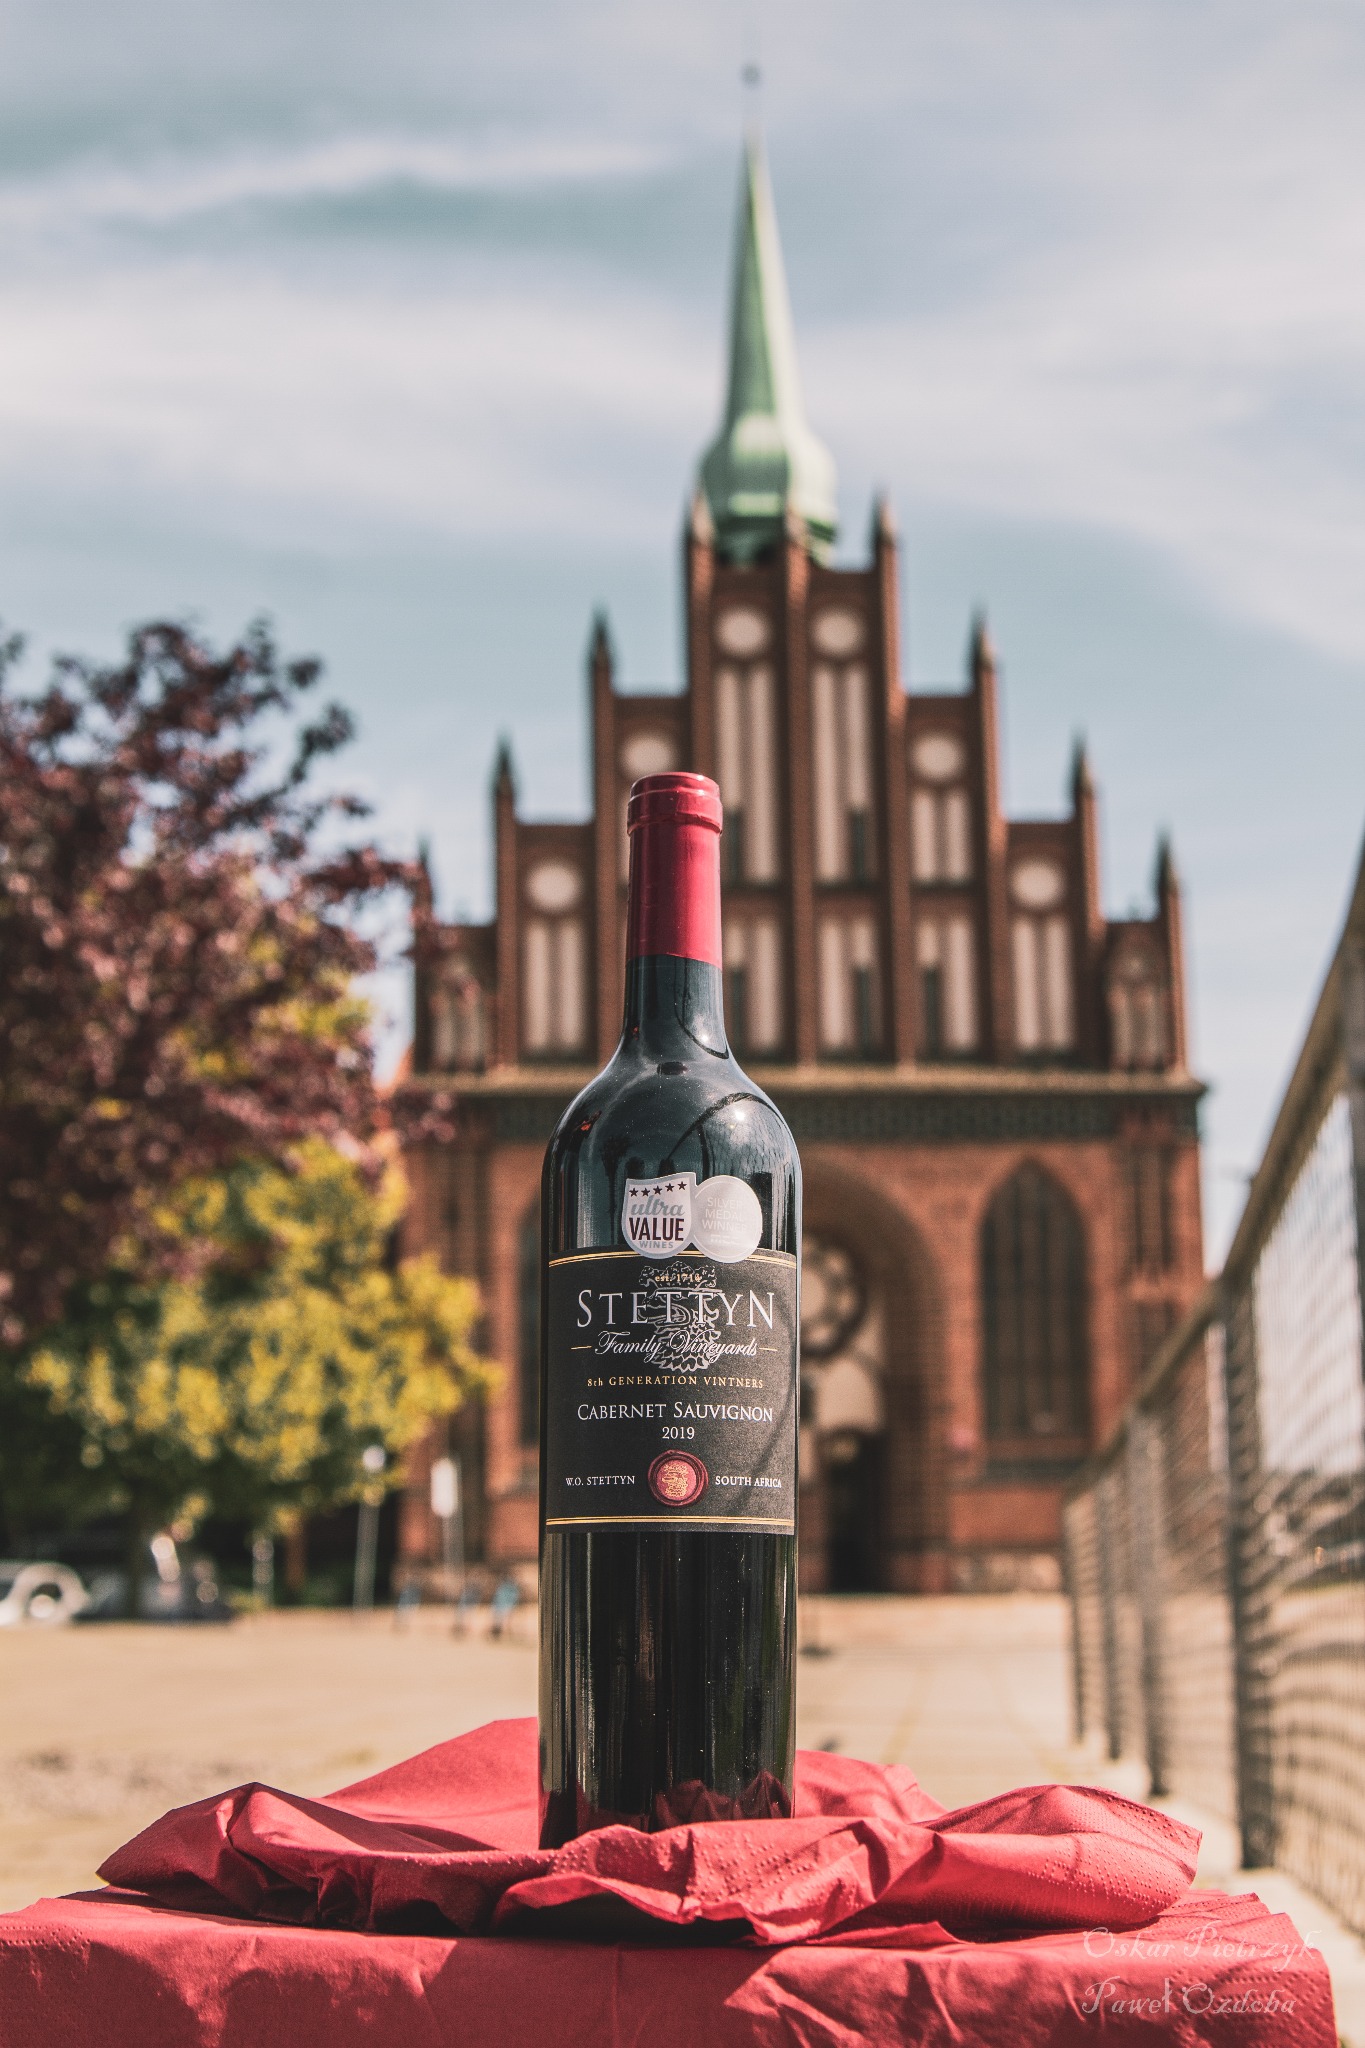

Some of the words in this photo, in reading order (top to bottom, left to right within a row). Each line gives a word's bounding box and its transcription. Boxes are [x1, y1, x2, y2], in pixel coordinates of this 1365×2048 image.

[630, 1195, 685, 1217] ultra
[707, 1197, 743, 1210] SILVER
[705, 1208, 744, 1222] MEDAL
[629, 1217, 684, 1241] VALUE
[639, 1240, 674, 1249] WINES
[577, 1289, 774, 1330] STETTYN
[595, 1331, 662, 1364] Family
[669, 1329, 758, 1364] Vineyards
[587, 1378, 603, 1387] 8th
[608, 1376, 698, 1386] GENERATION
[704, 1376, 764, 1389] VINTNERS
[577, 1404, 667, 1421] CABERNET
[673, 1401, 774, 1422] SAUVIGNON
[662, 1426, 695, 1440] 2019
[565, 1477, 584, 1486] W.O.
[586, 1475, 636, 1486] STETTYN
[715, 1475, 752, 1487] SOUTH
[754, 1477, 782, 1489] AFRICA
